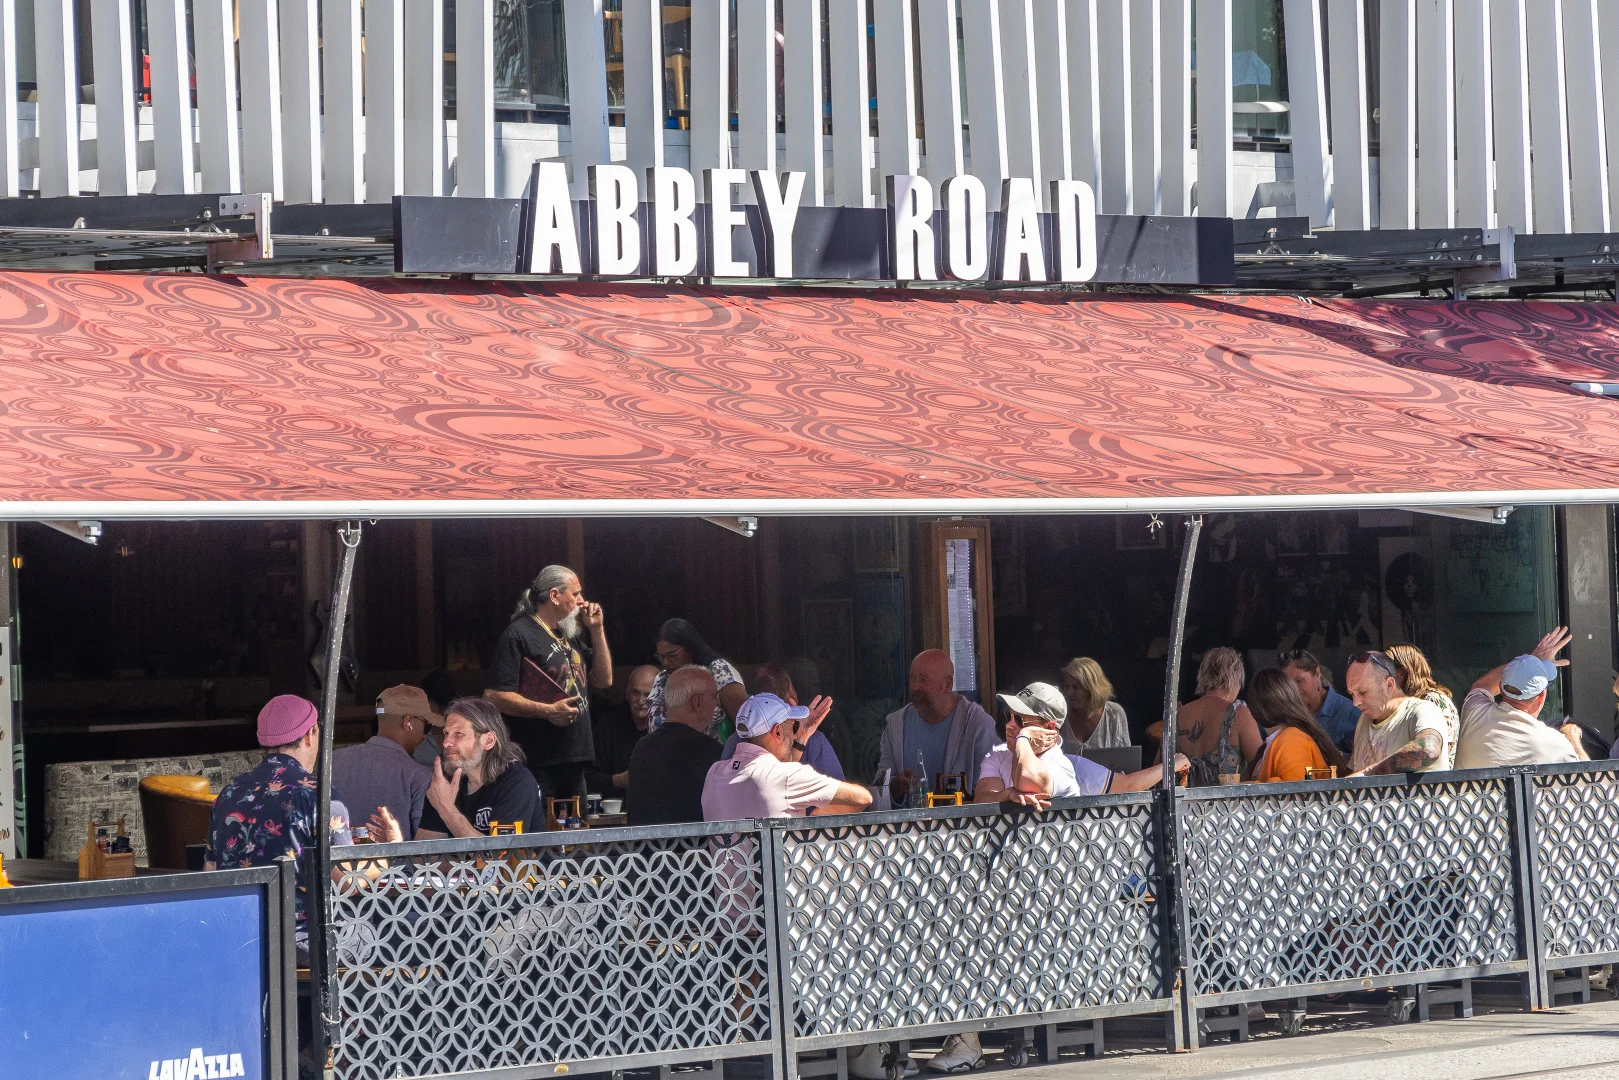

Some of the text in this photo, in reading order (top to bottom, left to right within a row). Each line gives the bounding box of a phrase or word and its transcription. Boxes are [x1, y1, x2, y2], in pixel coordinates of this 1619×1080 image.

[529, 161, 1098, 282] ABBEY ROAD
[149, 1048, 245, 1080] LAVAZZA
